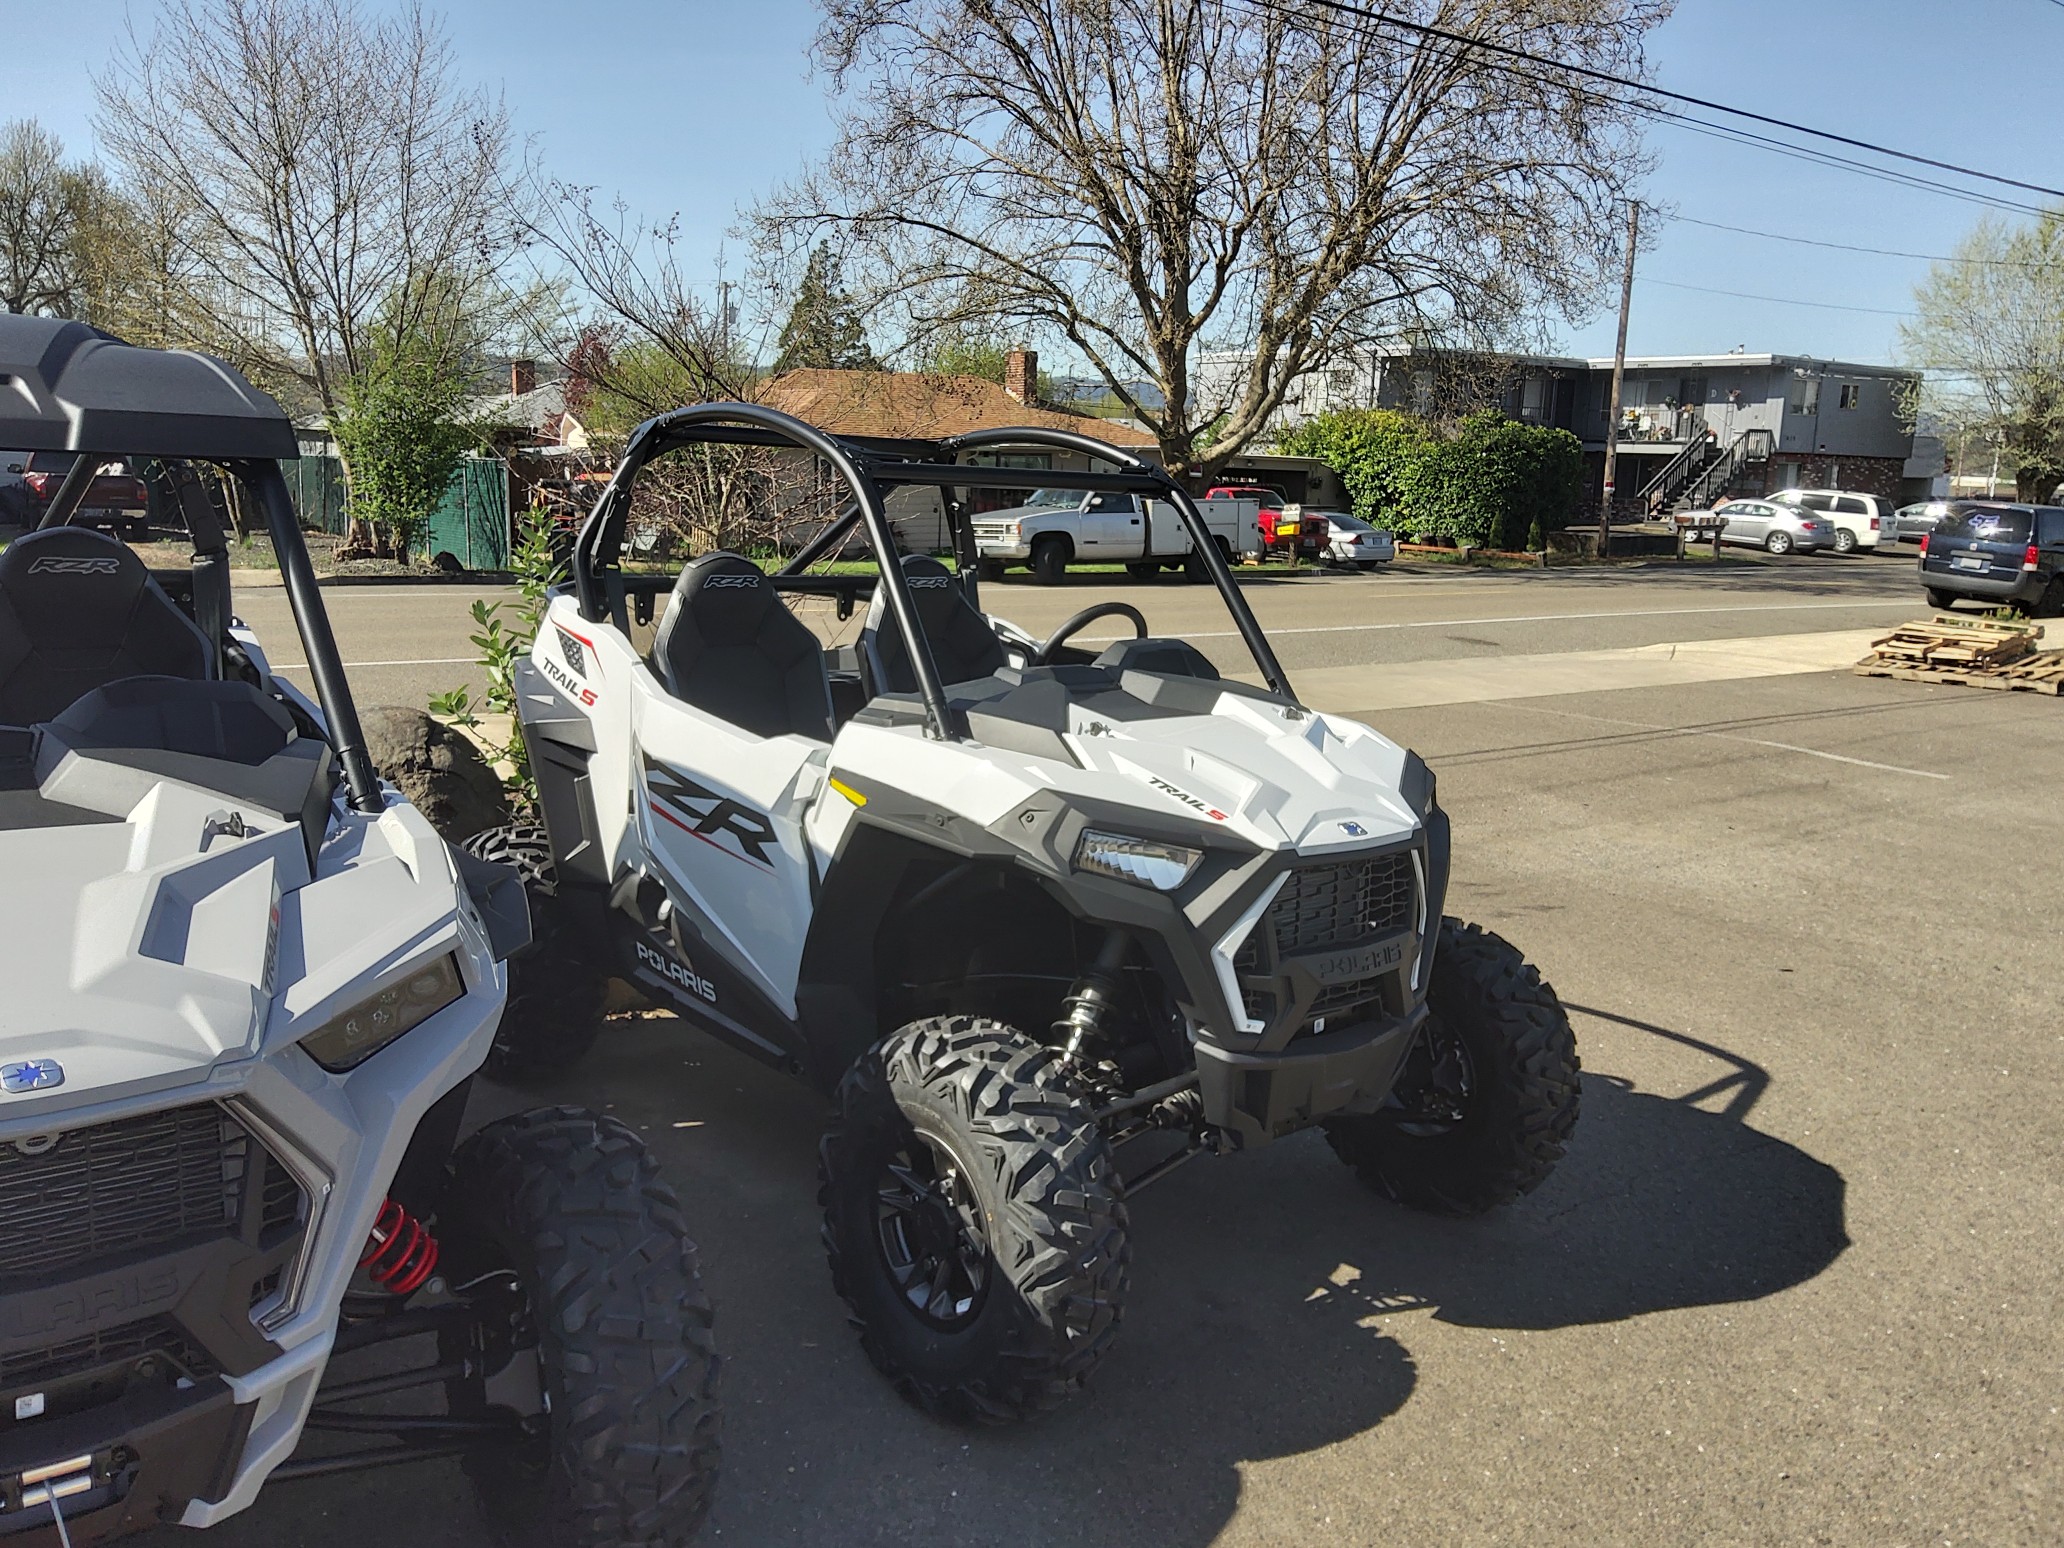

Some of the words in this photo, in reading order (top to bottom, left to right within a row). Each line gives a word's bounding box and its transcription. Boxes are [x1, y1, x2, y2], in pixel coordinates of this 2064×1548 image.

[28, 557, 120, 574] RZR
[703, 575, 760, 588] RZR
[543, 657, 579, 697] TRAIL
[579, 688, 599, 707] S
[1149, 776, 1206, 812] TRAIL
[1205, 809, 1229, 821] S
[636, 941, 717, 1002] POLARIS
[1319, 943, 1403, 979] POLARIS
